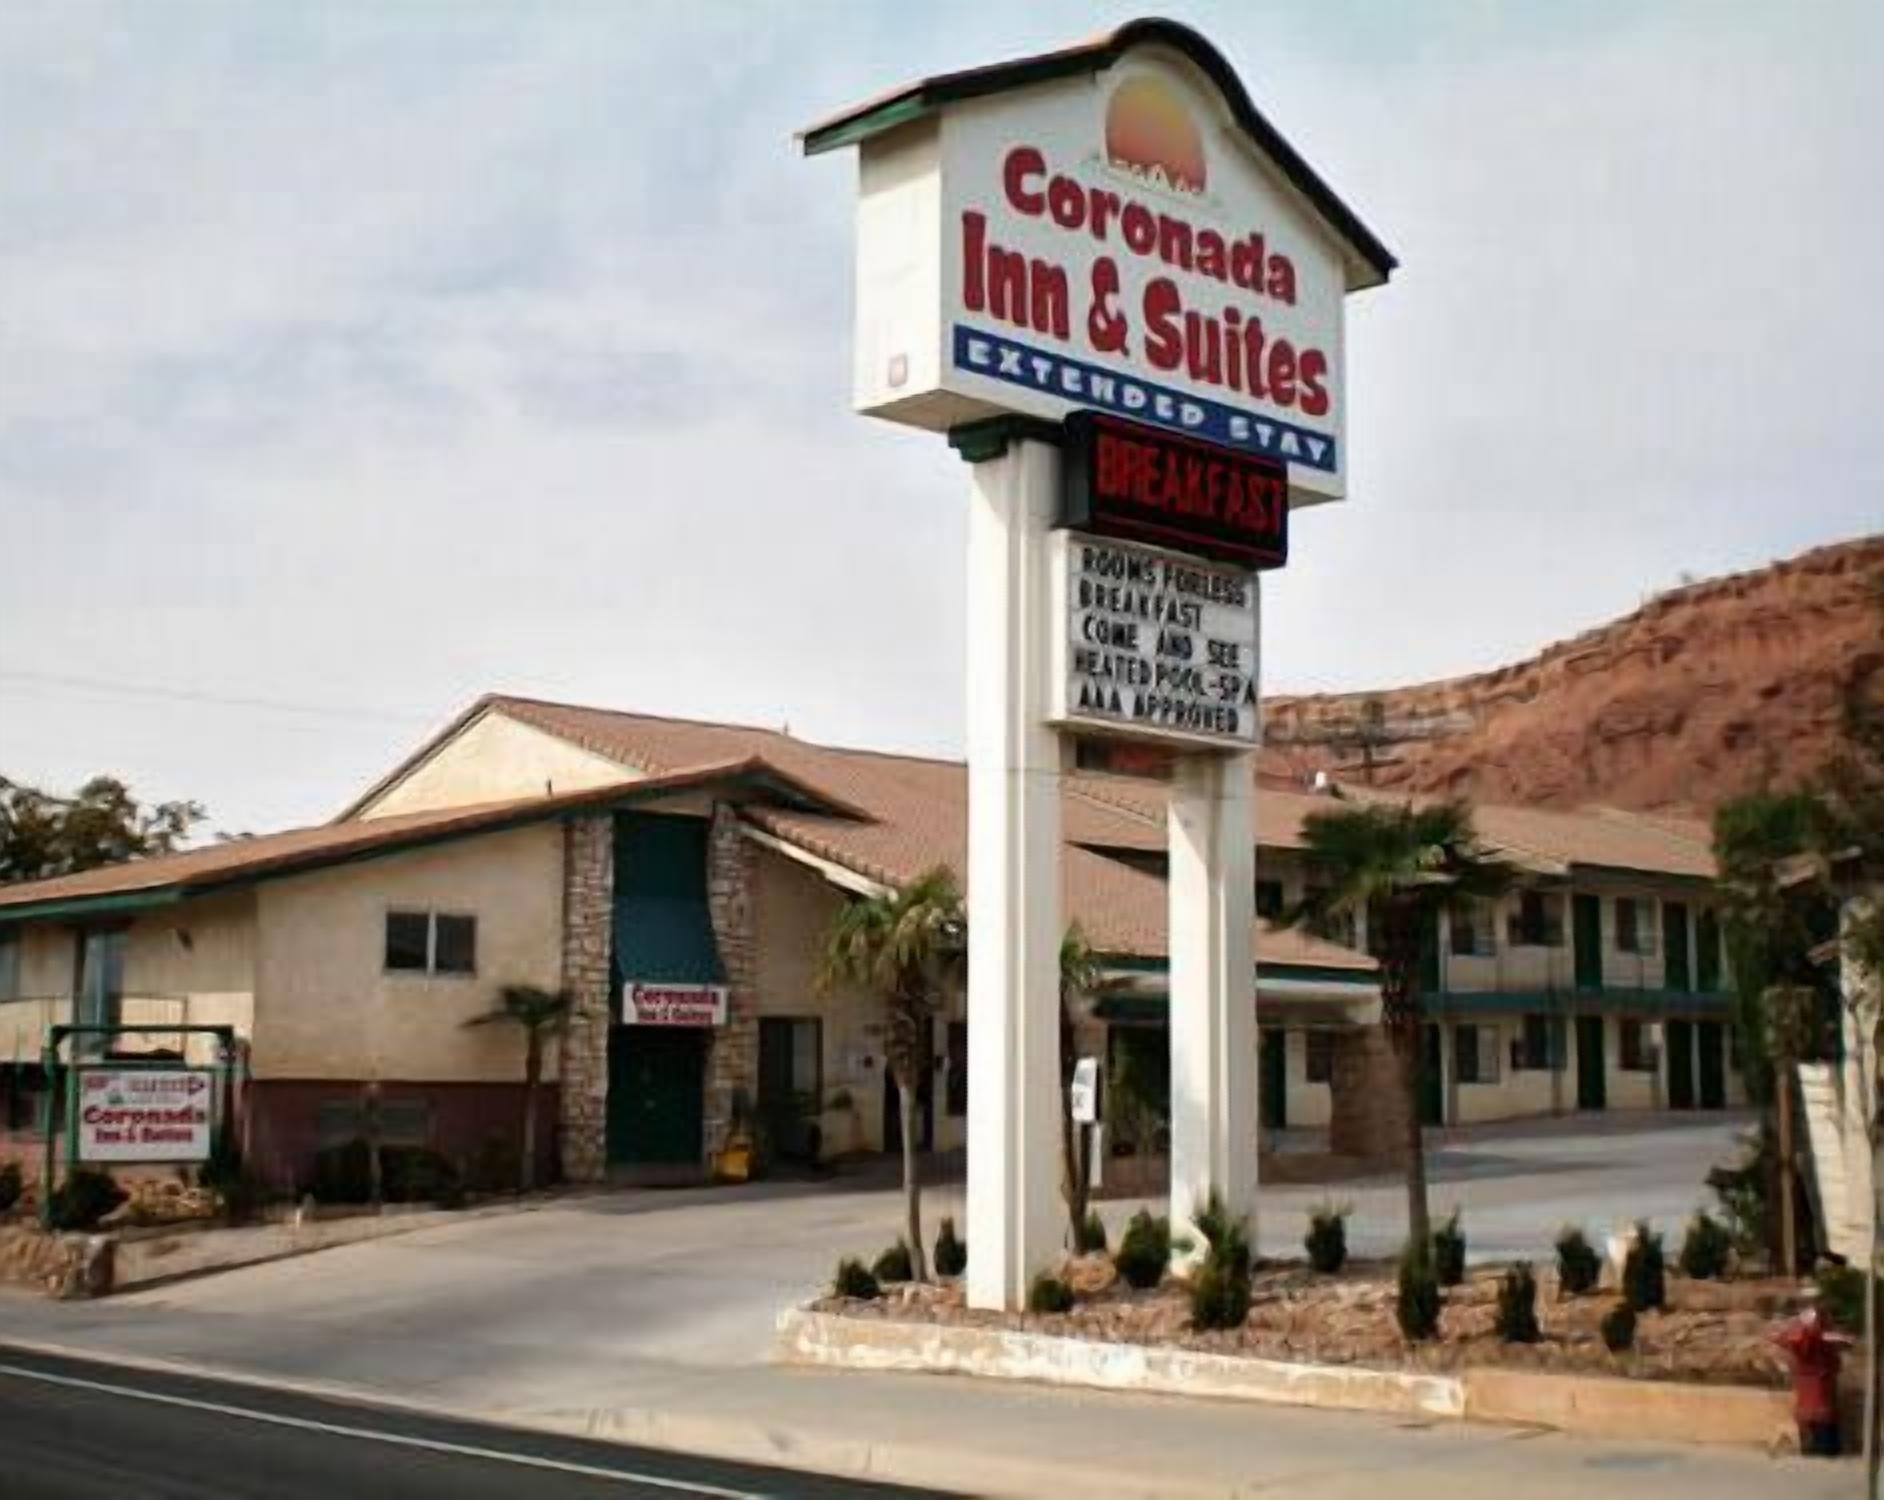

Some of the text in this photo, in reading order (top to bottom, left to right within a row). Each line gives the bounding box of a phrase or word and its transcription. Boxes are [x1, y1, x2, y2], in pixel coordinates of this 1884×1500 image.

[1003, 146, 1296, 304] Coronada
[962, 210, 1329, 416] Inn & Suites
[967, 339, 1328, 463] EXTENDED STAY
[1096, 432, 1283, 535] BREAKFAST
[1082, 547, 1156, 584] ROOMS
[1079, 579, 1202, 632] BREAKFAST
[1075, 649, 1151, 685] HEATED
[1083, 615, 1138, 649] COME
[1207, 639, 1240, 668] SEE
[1080, 682, 1122, 712] AAA
